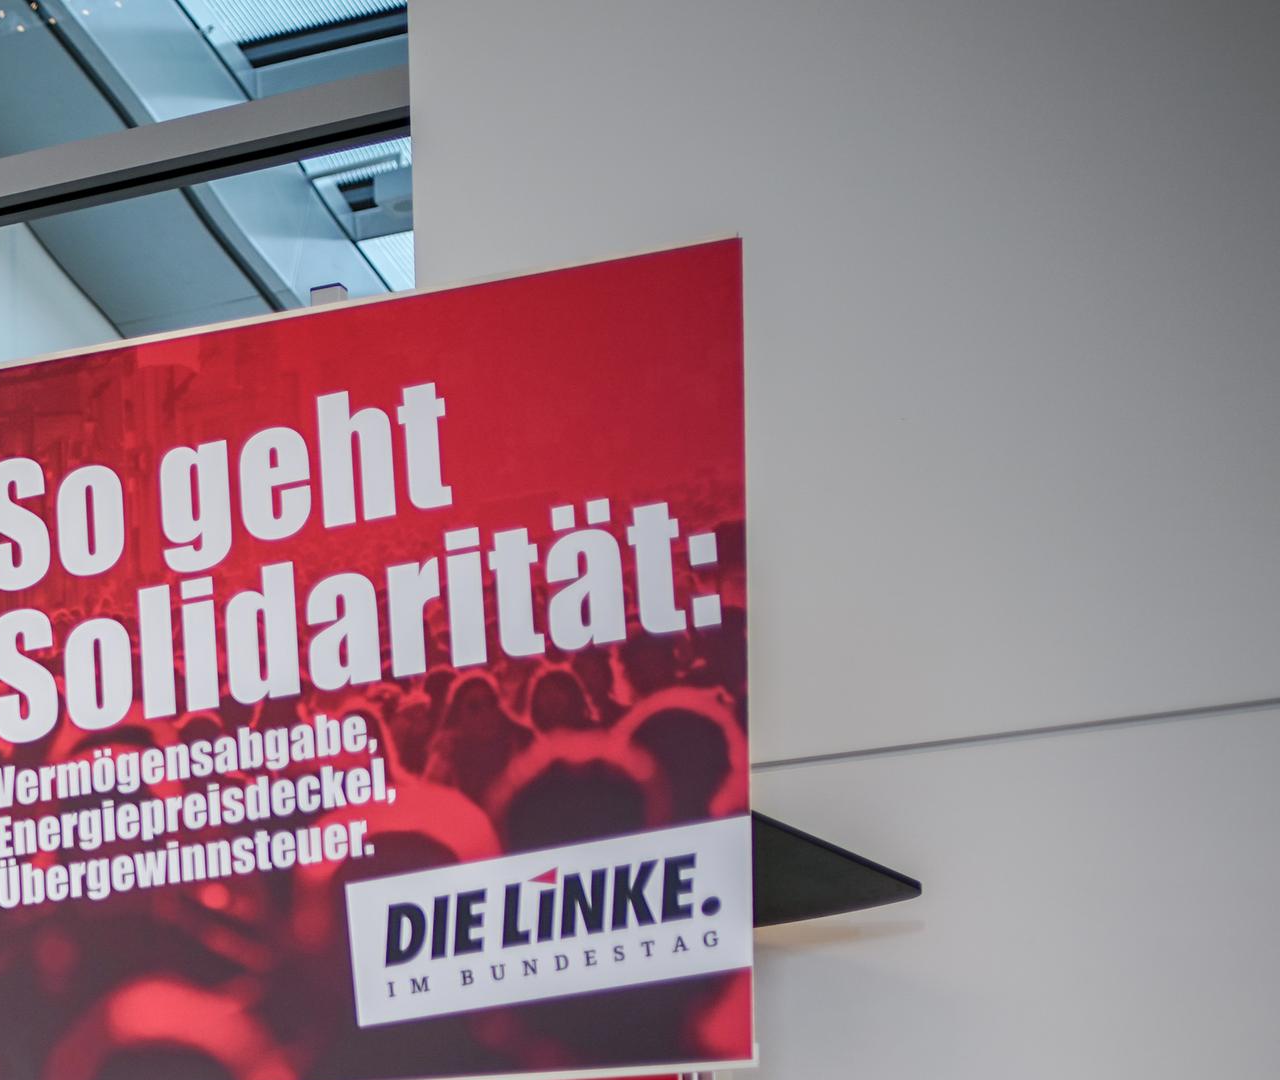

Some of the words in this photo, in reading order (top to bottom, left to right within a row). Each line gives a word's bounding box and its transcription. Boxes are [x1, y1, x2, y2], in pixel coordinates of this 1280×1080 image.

[159, 382, 453, 574] geht
[385, 888, 488, 968] DIE
[387, 975, 430, 998] IM
[460, 931, 720, 987] BUNDESTAG
